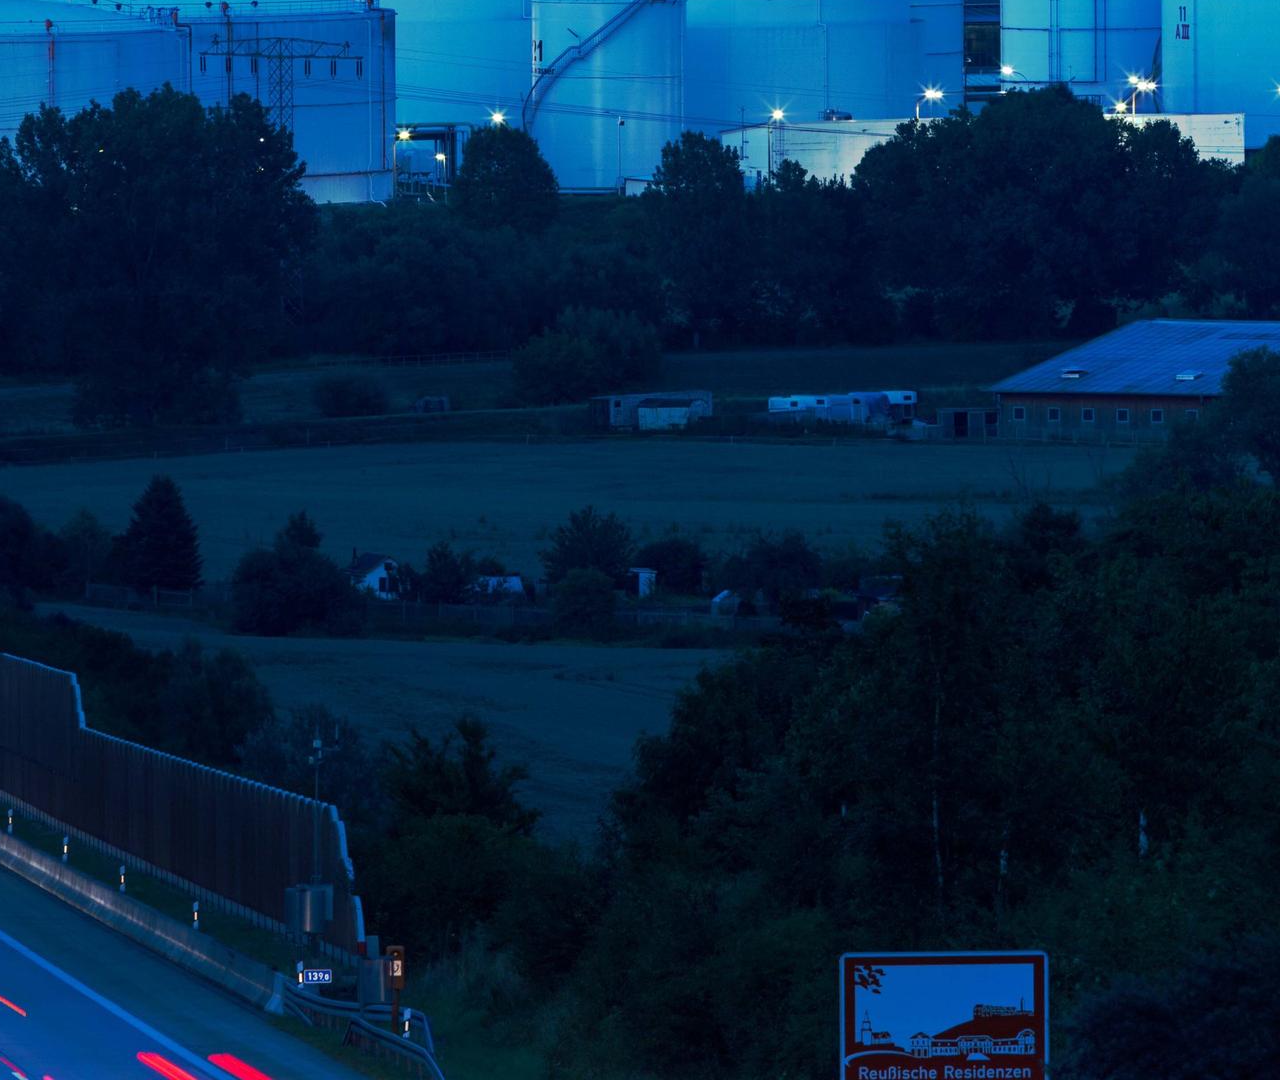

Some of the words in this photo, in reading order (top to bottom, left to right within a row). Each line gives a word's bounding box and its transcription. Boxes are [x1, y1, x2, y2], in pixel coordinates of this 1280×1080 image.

[1178, 5, 1187, 22] 11
[1175, 23, 1181, 40] A
[857, 1066, 938, 1080] Reußische
[943, 1065, 1032, 1080] Residenzen
